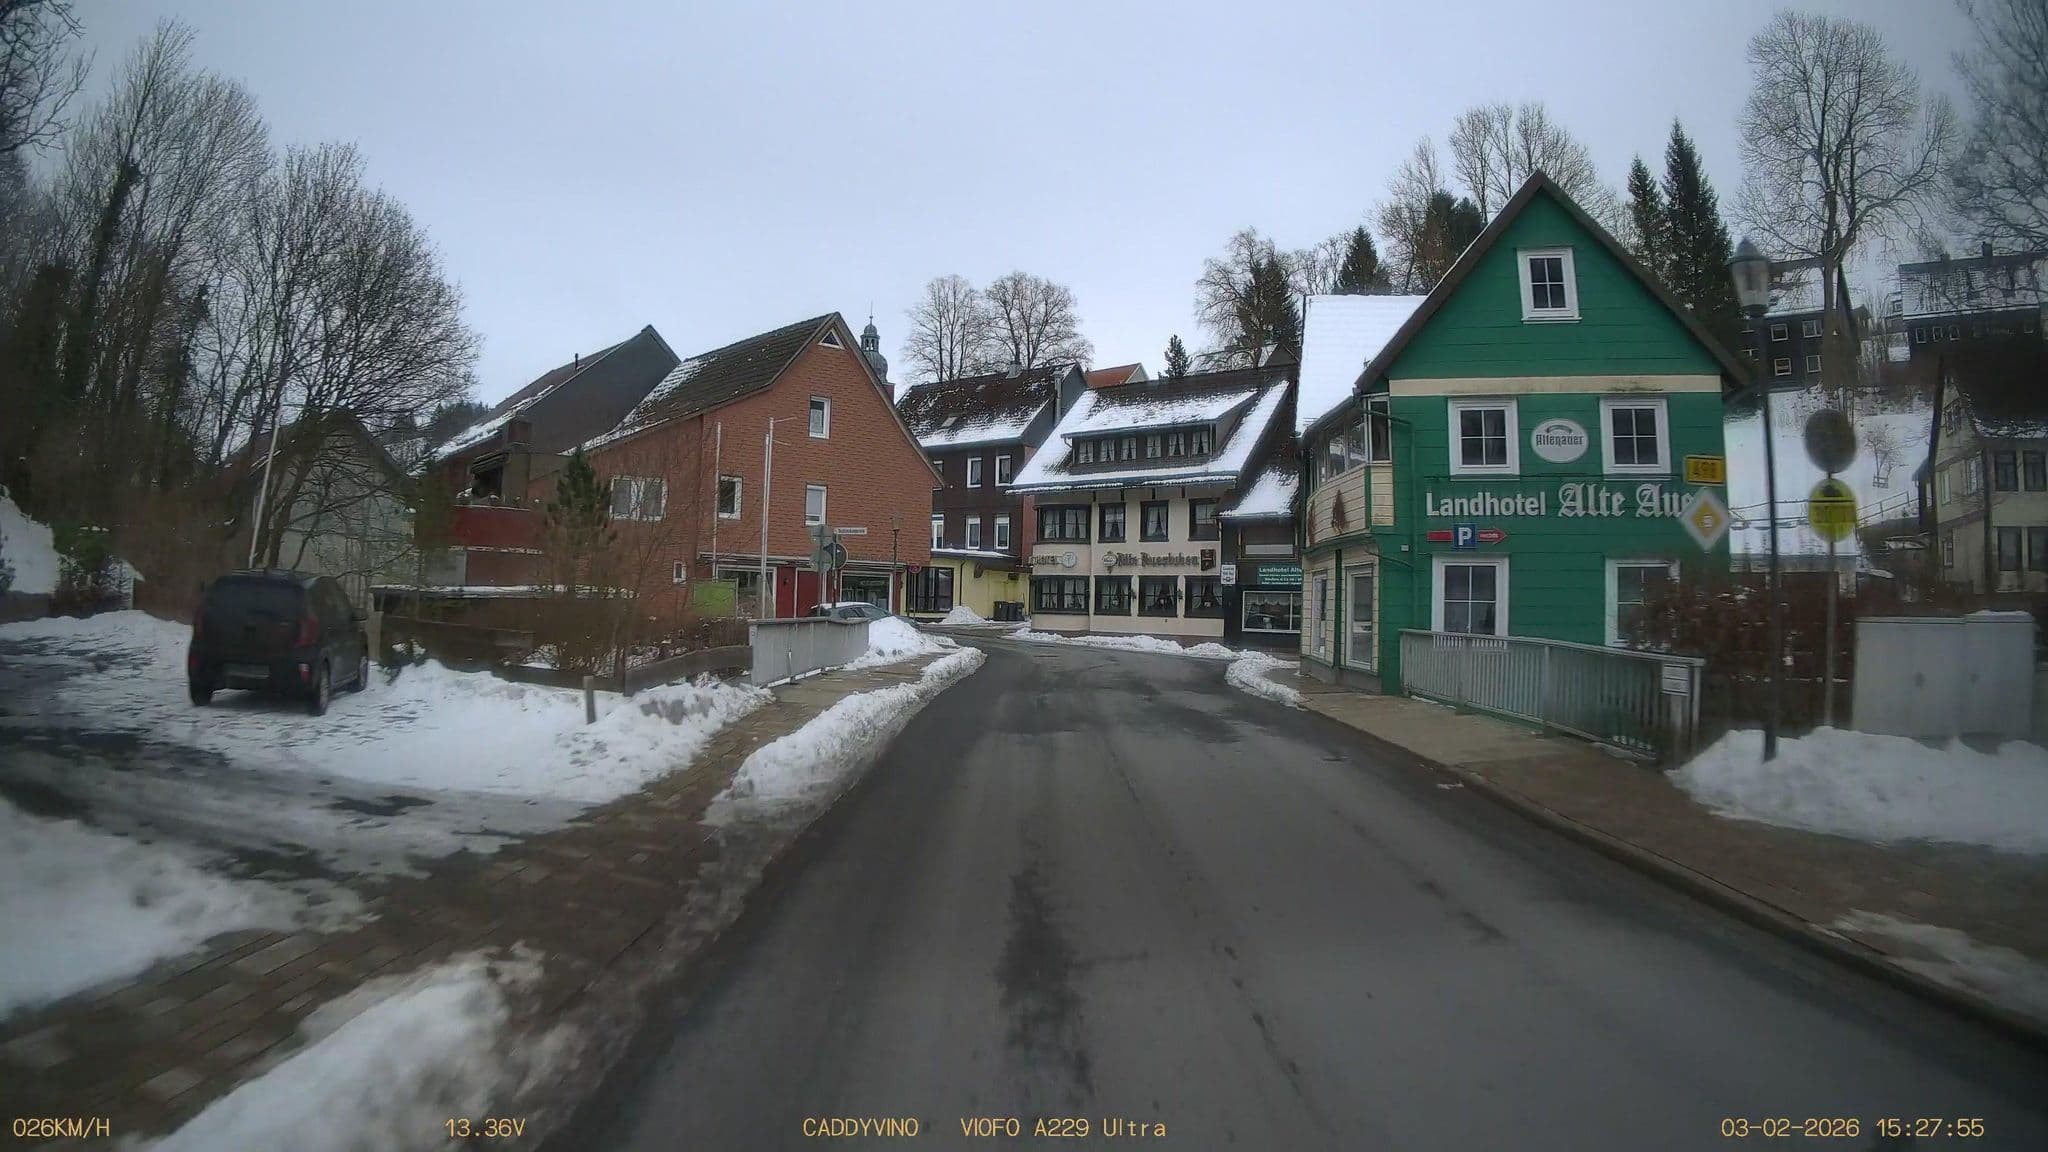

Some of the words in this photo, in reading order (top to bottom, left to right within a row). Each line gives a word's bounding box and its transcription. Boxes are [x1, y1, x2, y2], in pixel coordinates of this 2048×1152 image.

[1535, 434, 1585, 447] Altenauer
[1426, 491, 1546, 516] Landhotel
[1557, 483, 1626, 518] Alte
[1458, 527, 1473, 546] P
